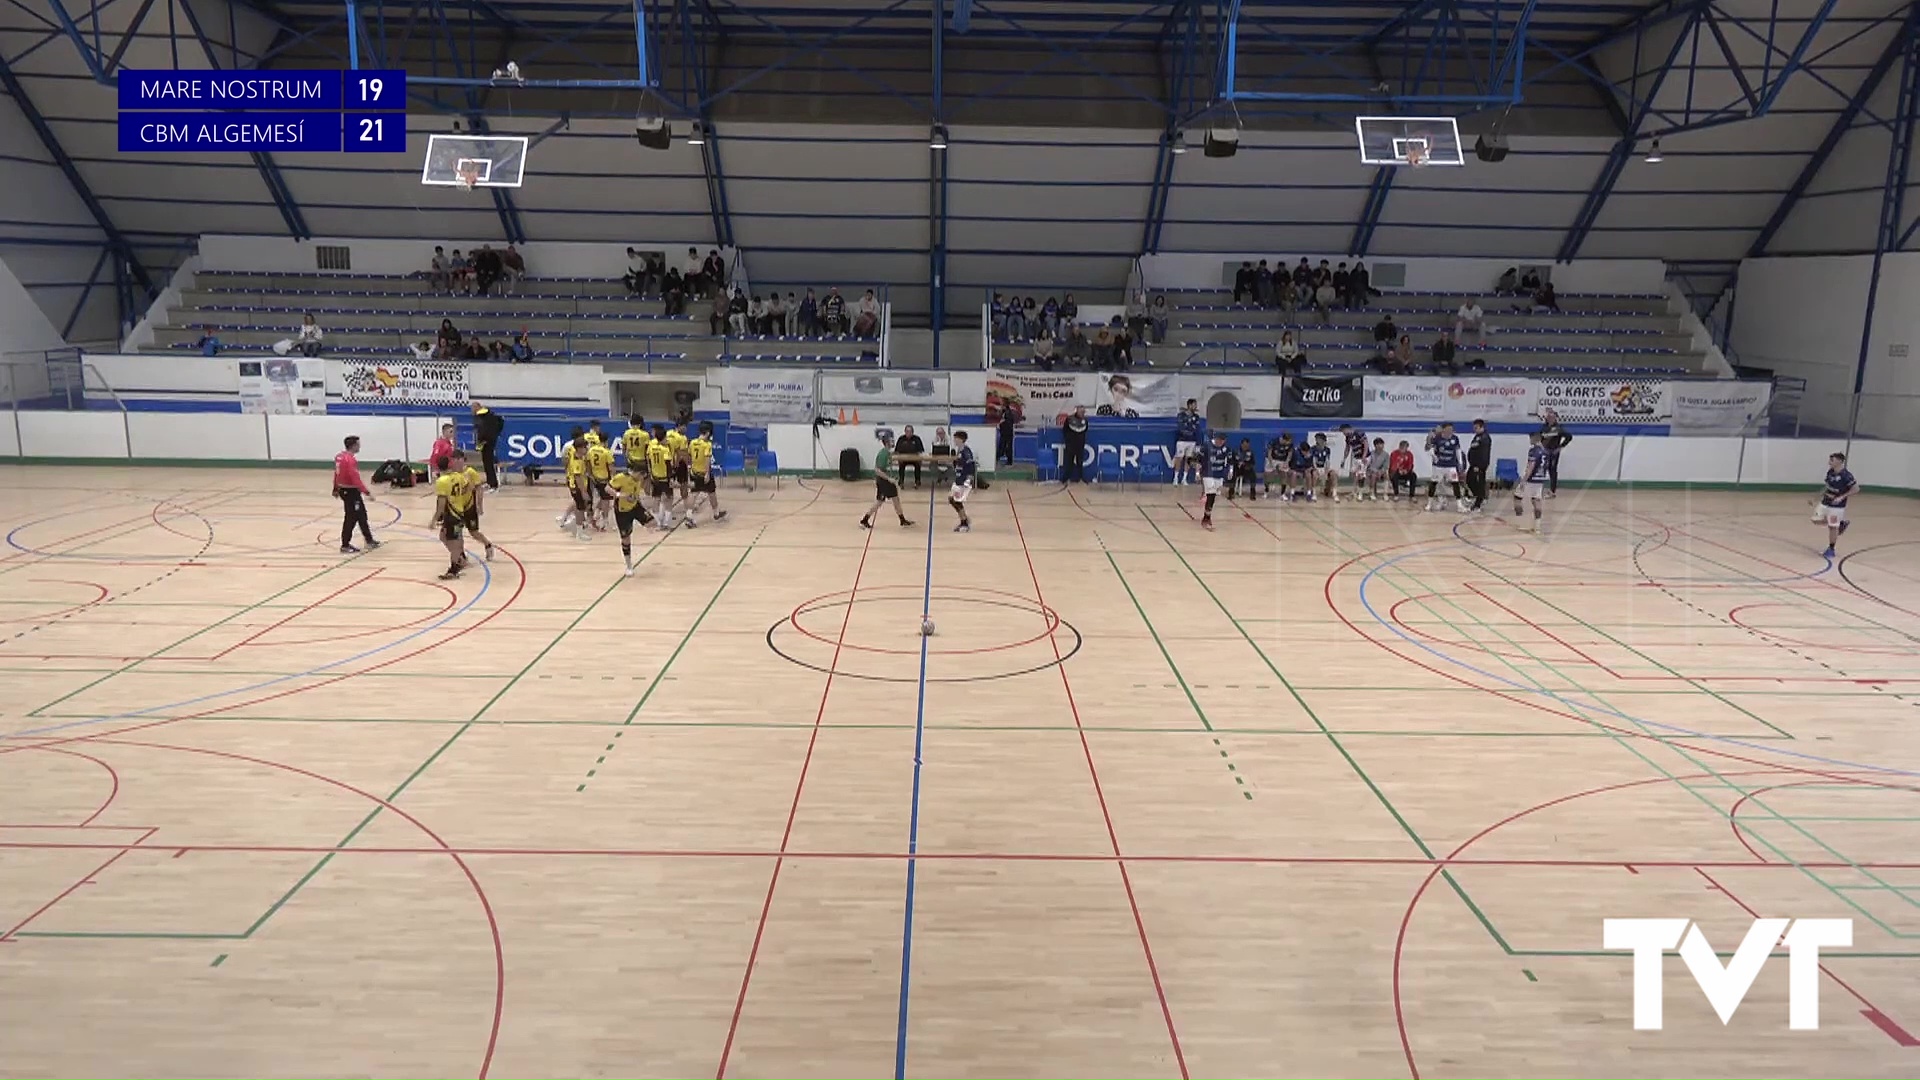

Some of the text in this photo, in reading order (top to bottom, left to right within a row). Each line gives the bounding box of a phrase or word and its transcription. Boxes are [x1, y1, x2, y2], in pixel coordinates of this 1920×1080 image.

[401, 366, 463, 382] GO KARTS
[396, 380, 469, 392] ORIHUELA COSTA
[1465, 386, 1497, 395] General
[1545, 385, 1606, 398] GO KARTS
[1302, 386, 1341, 402] zariko
[1539, 398, 1612, 408] CIUDAD QUESADA
[629, 436, 640, 447] 14
[593, 454, 600, 466] 2
[652, 452, 660, 464] 11
